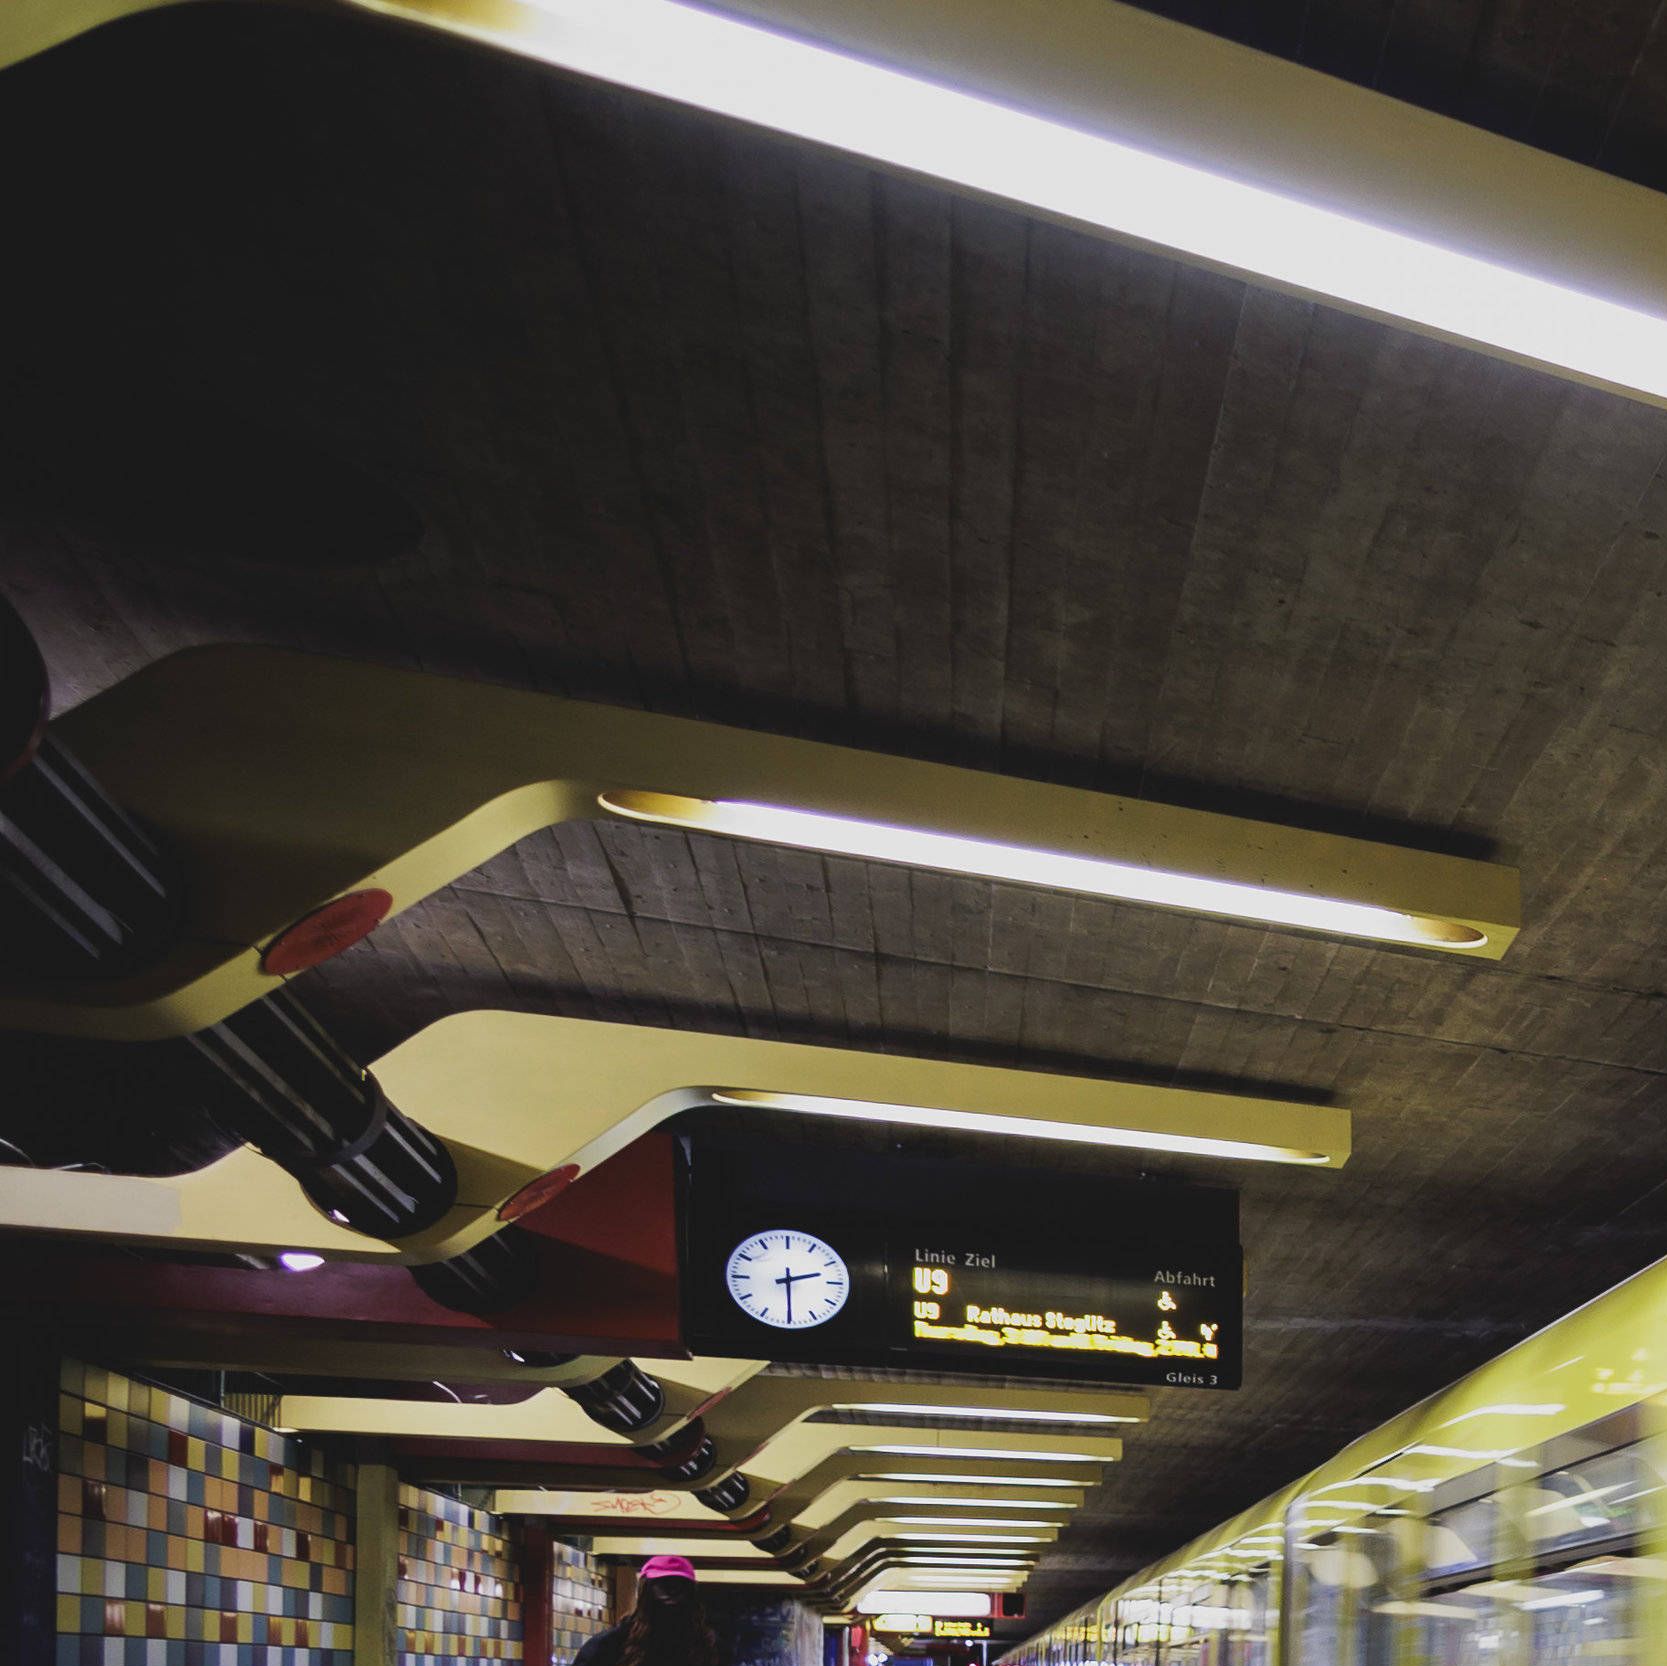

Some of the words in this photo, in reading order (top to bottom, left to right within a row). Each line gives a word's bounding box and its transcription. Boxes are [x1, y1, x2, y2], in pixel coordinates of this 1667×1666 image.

[914, 1248, 957, 1266] Linie
[964, 1252, 996, 1269] Ziel
[912, 1267, 950, 1297] U9
[1154, 1269, 1217, 1288] Abfahrt
[913, 1300, 941, 1321] U9
[965, 1304, 1043, 1329] Rathaus
[1044, 1311, 1117, 1335] Steglitz
[1165, 1372, 1205, 1385] Gleis
[1208, 1375, 1219, 1386] 3
